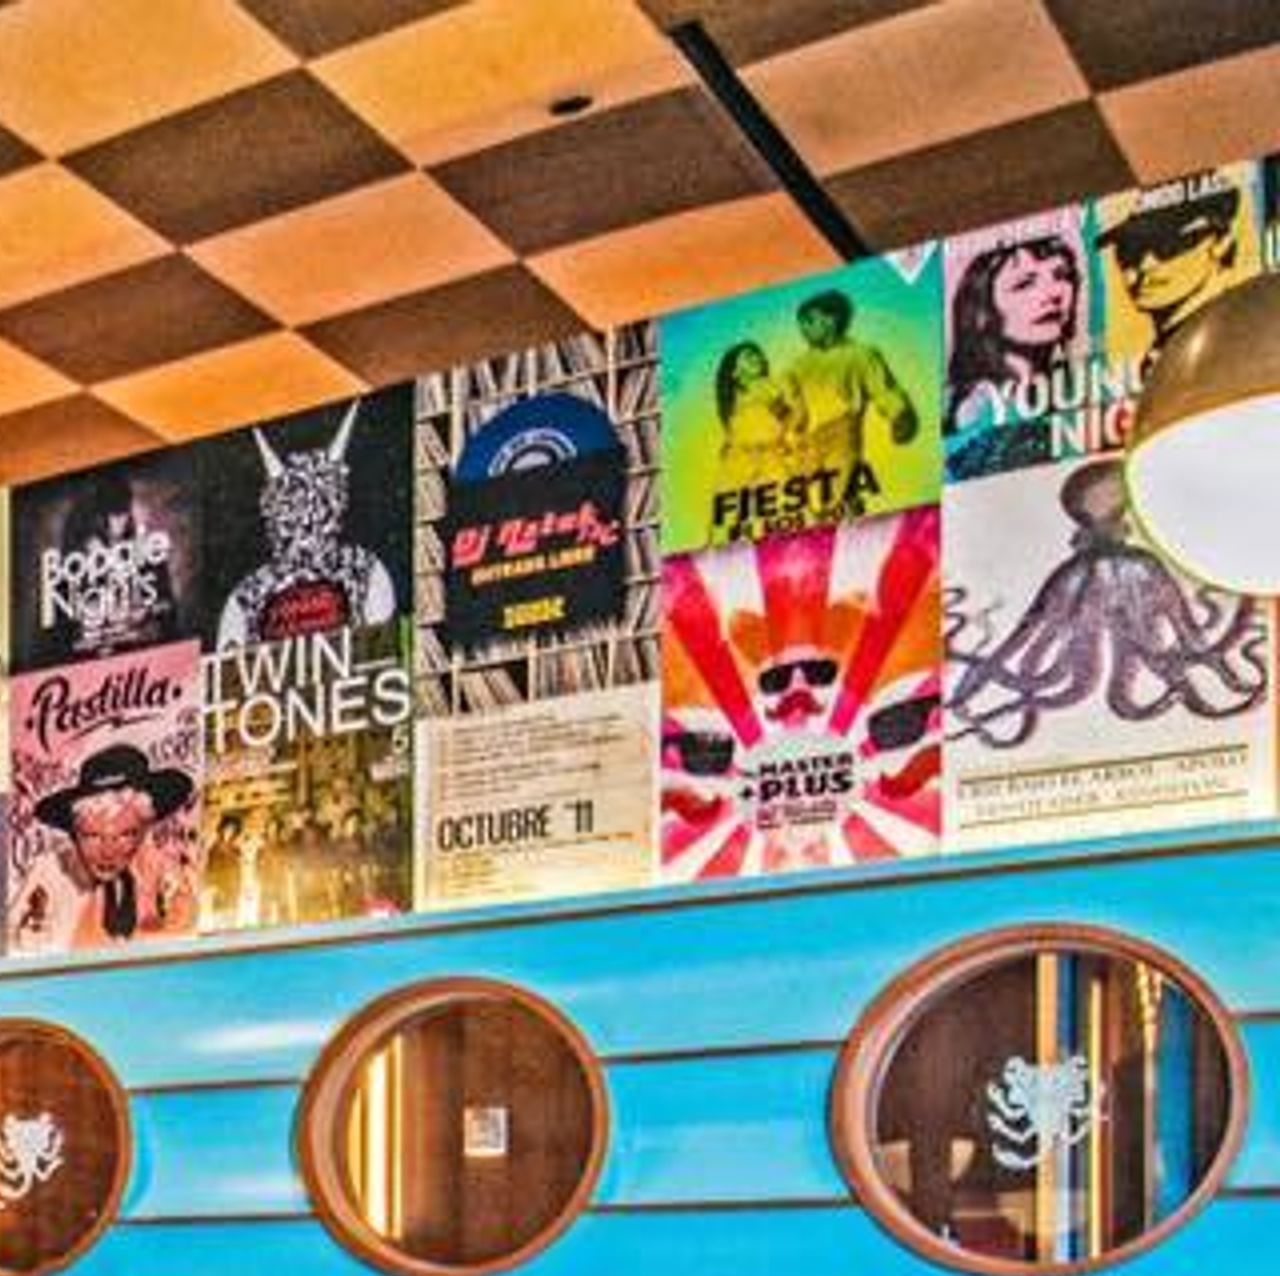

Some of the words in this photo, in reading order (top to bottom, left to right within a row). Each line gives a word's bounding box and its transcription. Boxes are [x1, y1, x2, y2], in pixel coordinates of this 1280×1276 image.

[714, 459, 881, 525] FIESTA
[201, 626, 351, 706] TWIN
[32, 666, 170, 753] Pastilla
[202, 668, 411, 752] TONES
[438, 804, 551, 852] OCTUBRE
